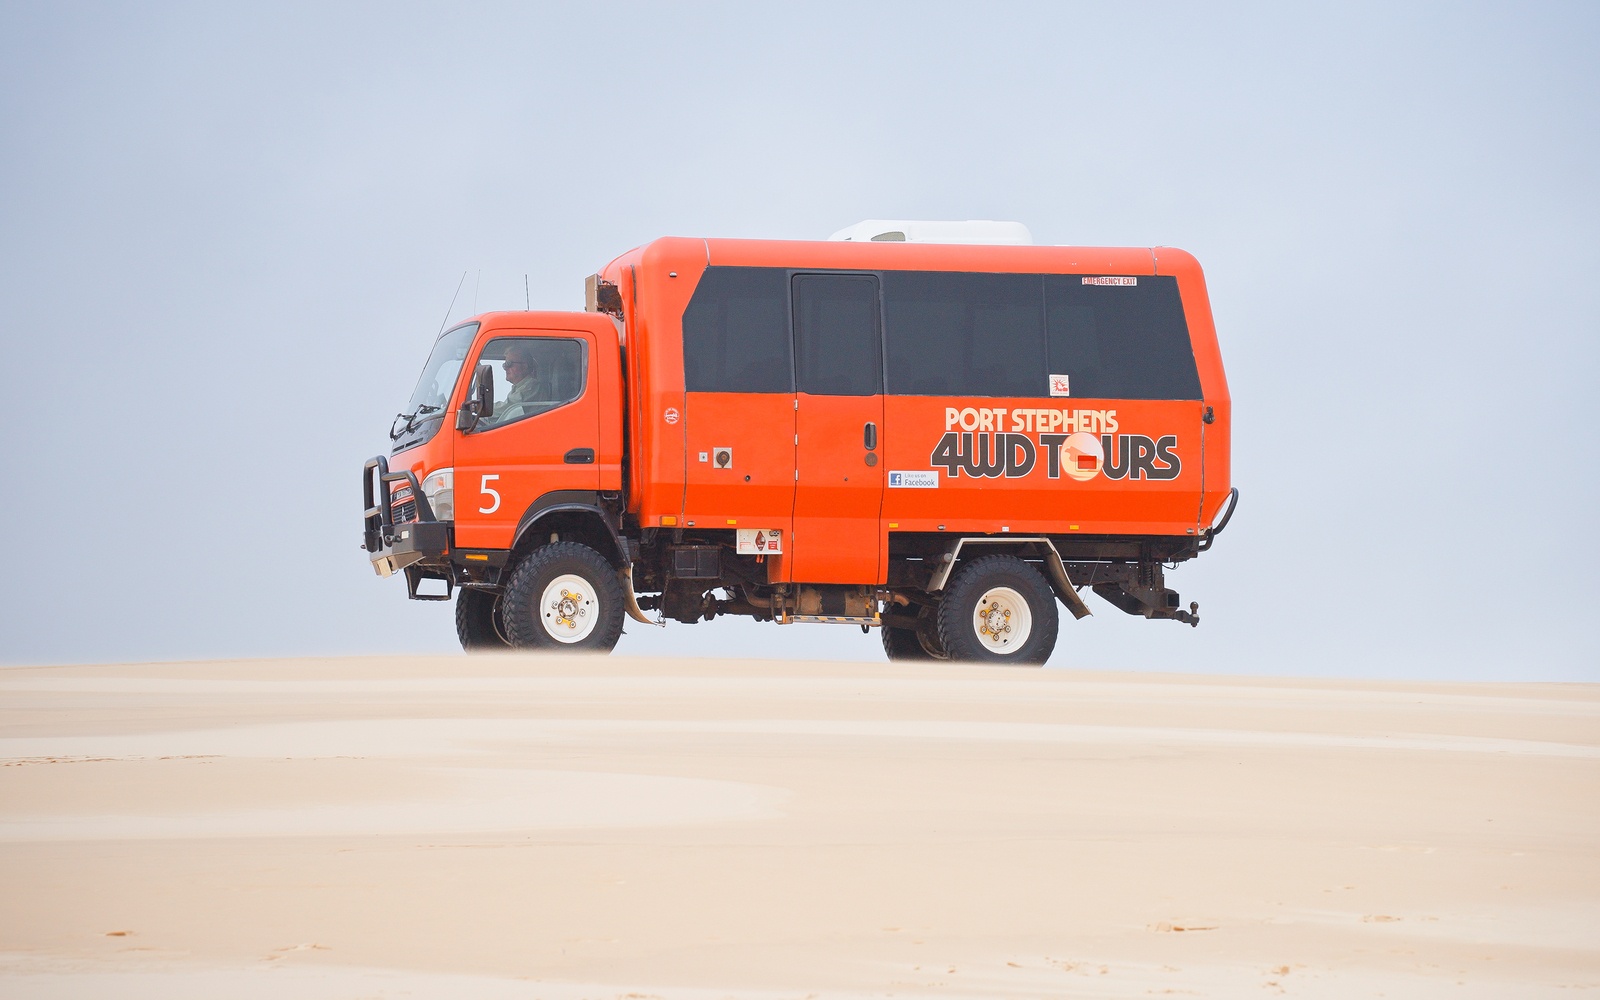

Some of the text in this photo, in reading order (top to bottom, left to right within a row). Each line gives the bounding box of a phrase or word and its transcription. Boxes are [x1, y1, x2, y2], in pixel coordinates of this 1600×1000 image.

[1083, 277, 1136, 285] EMERGENCY EXIT
[945, 407, 1119, 433] PORT STEPHENS
[931, 432, 1181, 481] 4WD TOURS
[478, 474, 501, 514] 5
